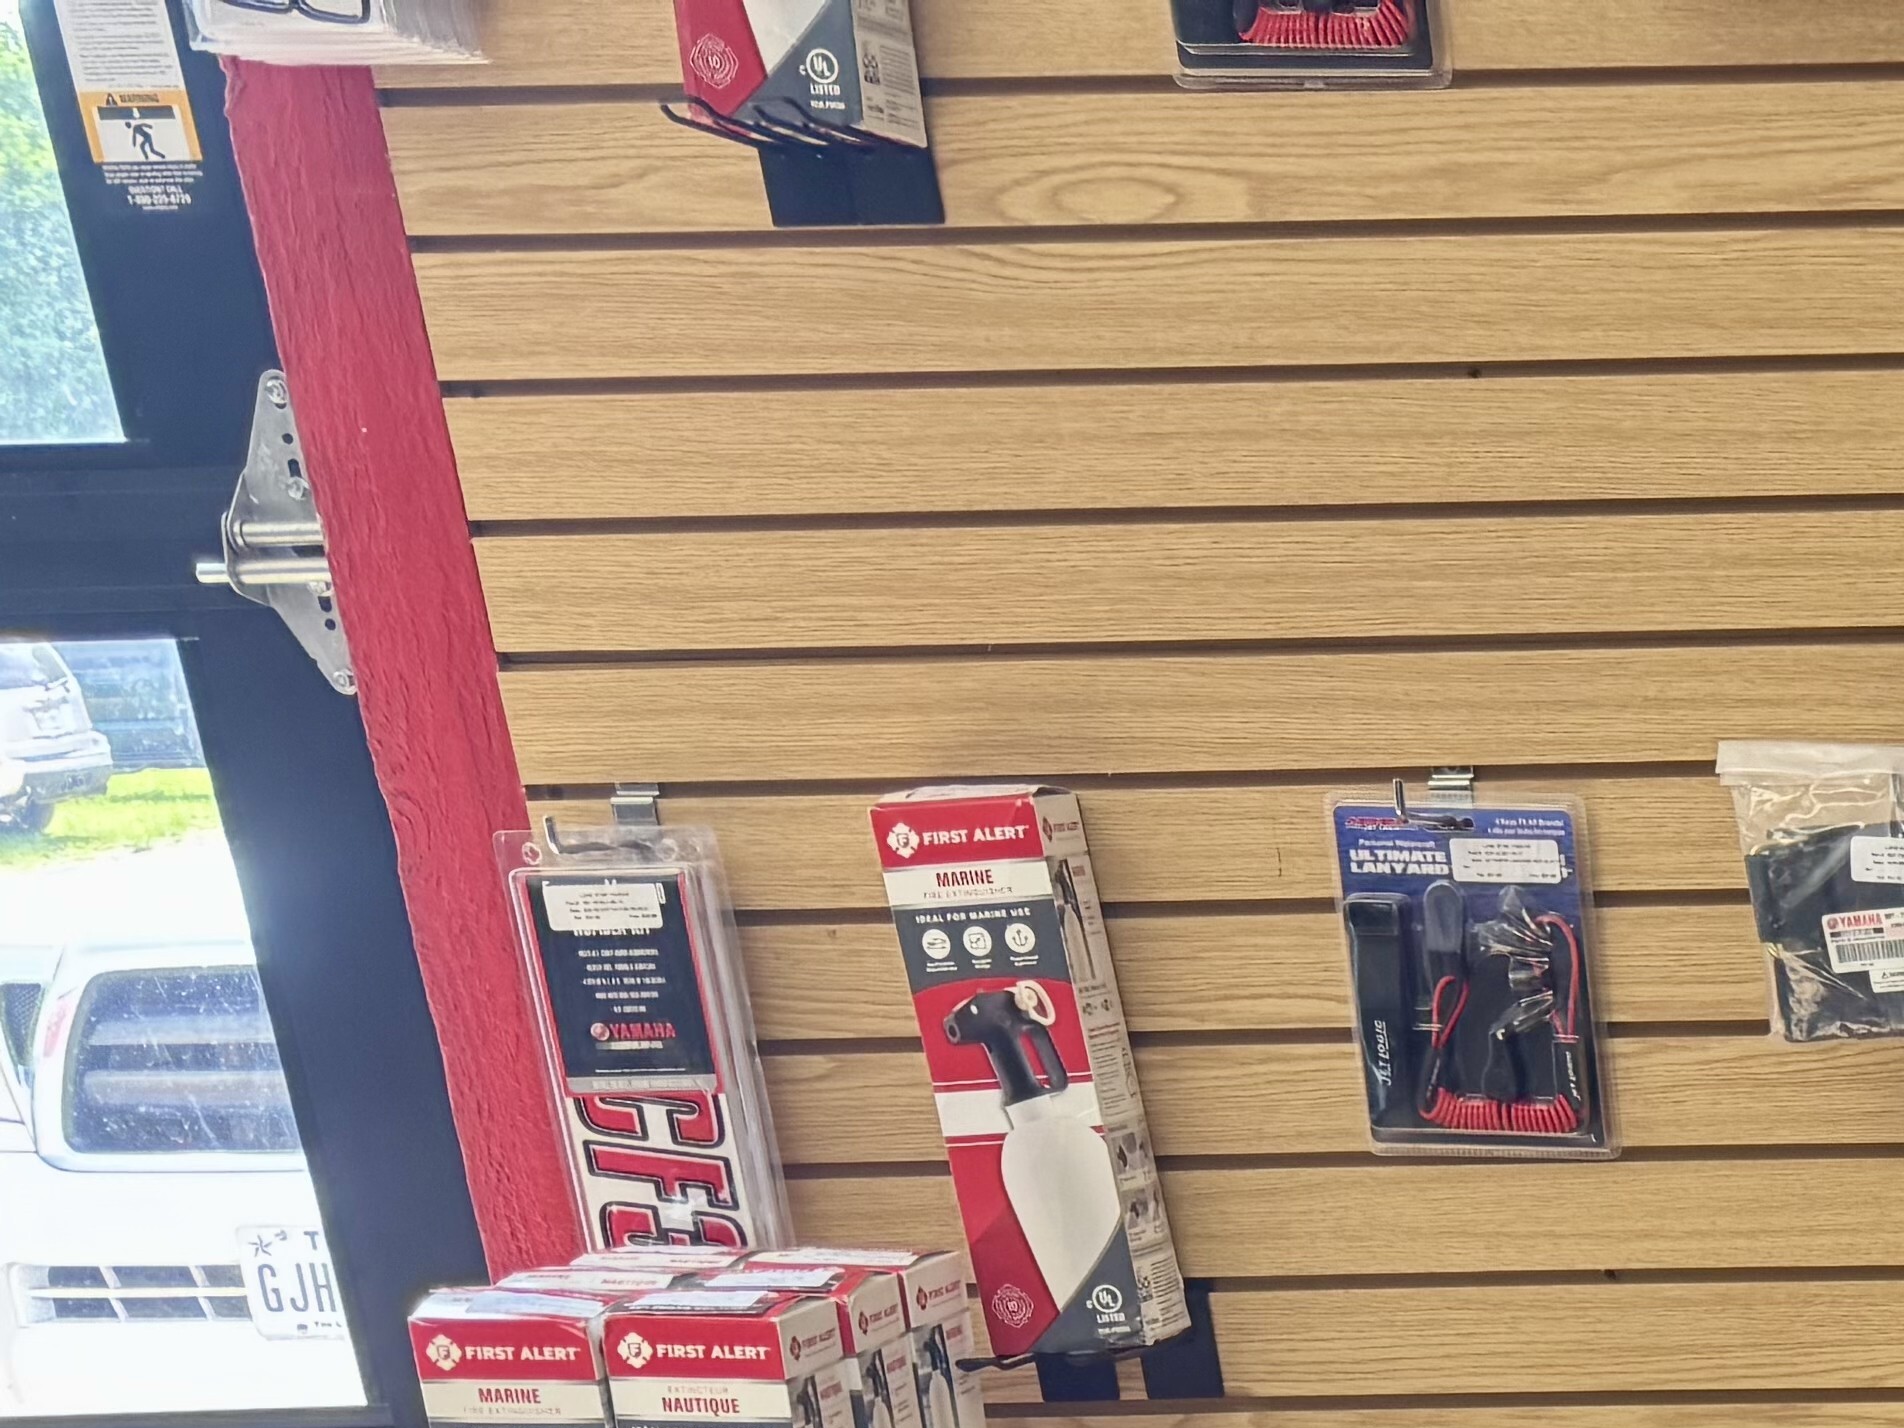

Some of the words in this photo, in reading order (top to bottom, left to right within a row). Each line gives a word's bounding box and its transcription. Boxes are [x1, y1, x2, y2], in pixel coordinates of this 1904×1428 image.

[923, 830, 968, 845] FIRST
[974, 826, 1026, 841] ALERT
[1349, 850, 1447, 862] ULTIMATE
[1351, 863, 1449, 875] LANYARD
[936, 870, 994, 887] MARINE
[916, 913, 943, 924] IDEAL
[947, 912, 966, 921] FOR
[969, 910, 1006, 920] MARINE
[1839, 913, 1883, 928] YAMAHA
[609, 1023, 675, 1038] YAMAHA
[465, 1347, 515, 1360] FIRST
[520, 1347, 577, 1360] ALERT
[656, 1345, 706, 1359] FIRST
[711, 1346, 767, 1360] ALERT
[478, 1388, 541, 1404] MARINE
[662, 1397, 740, 1414] NAUTIQUE
